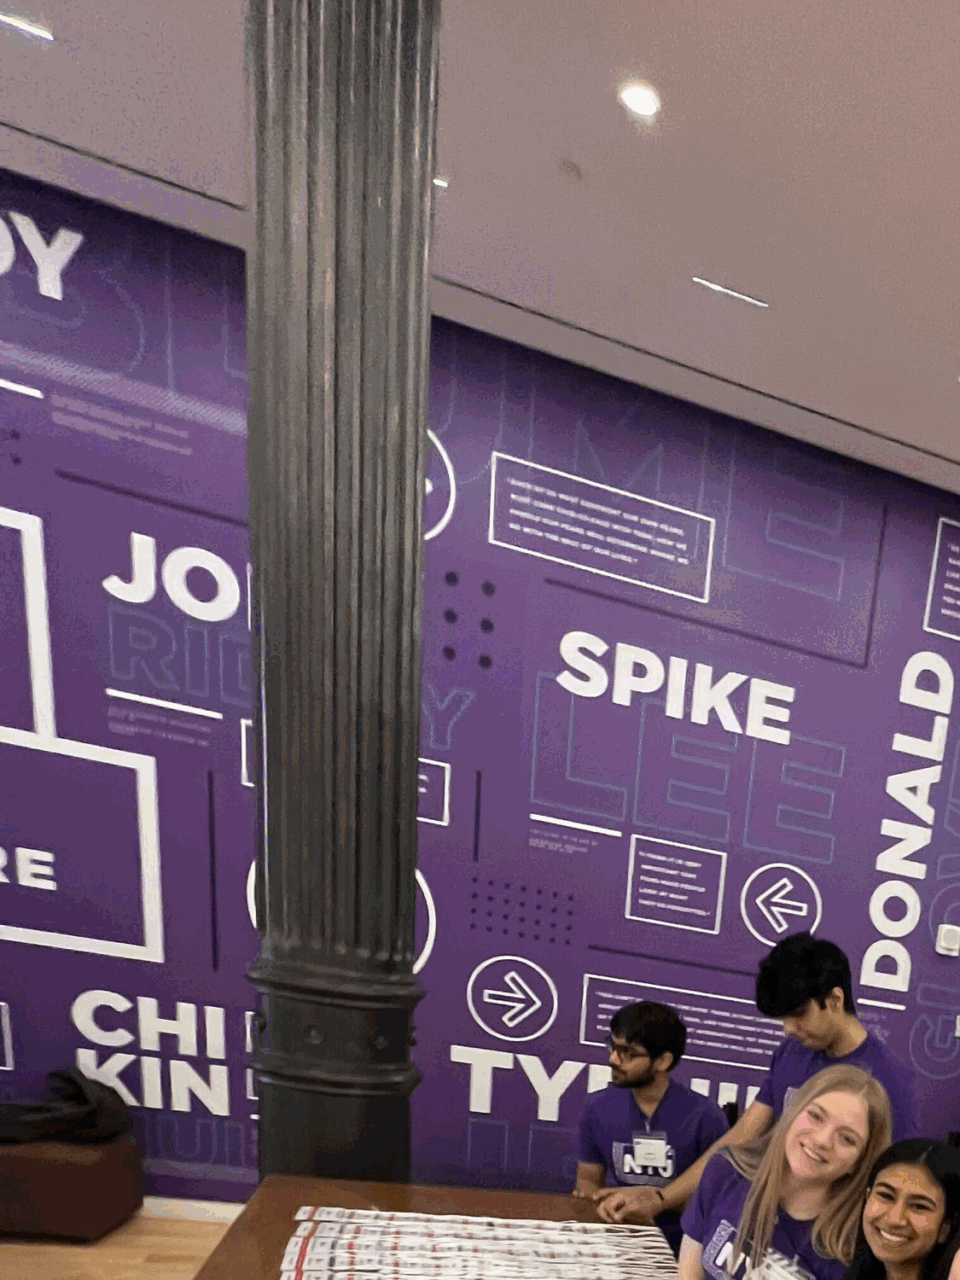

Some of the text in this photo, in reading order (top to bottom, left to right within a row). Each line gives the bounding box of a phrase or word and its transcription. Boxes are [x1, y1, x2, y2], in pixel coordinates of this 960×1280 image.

[102, 530, 252, 632] JO
[555, 631, 796, 746] SPIKE
[860, 651, 955, 993] DONALD
[71, 990, 226, 1060] CHI
[76, 1048, 231, 1117] KIN
[623, 1153, 676, 1179] NU
